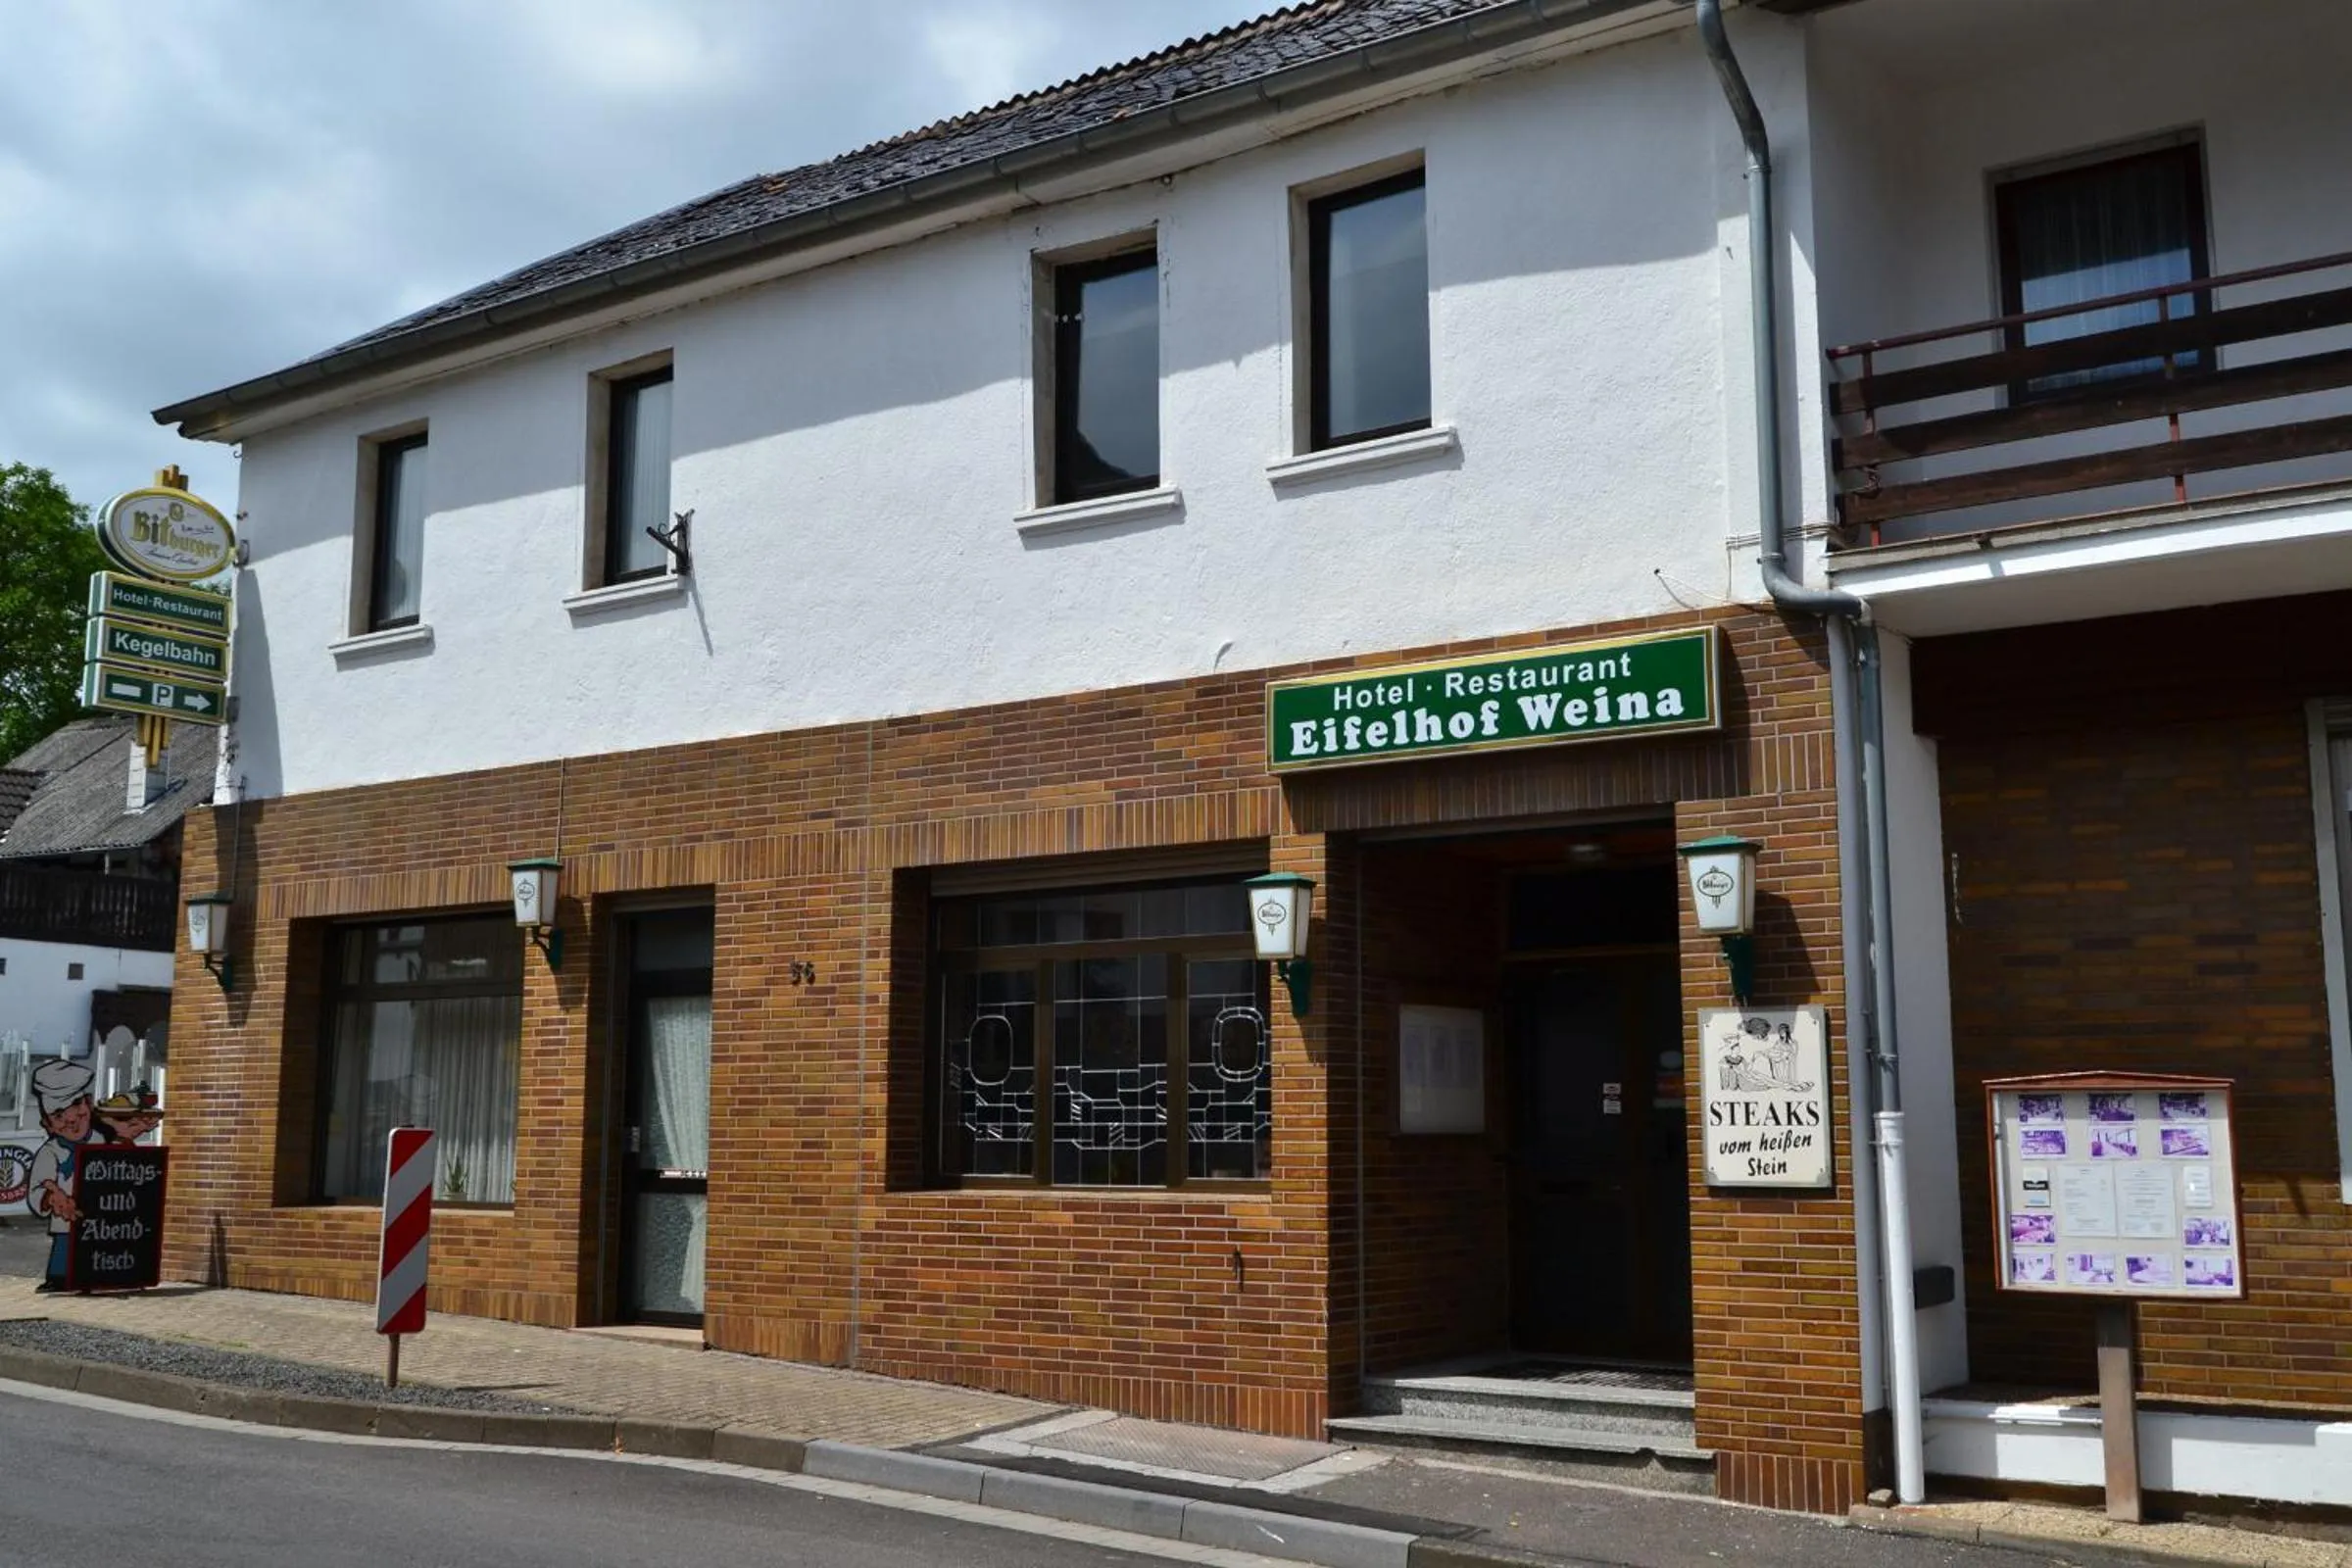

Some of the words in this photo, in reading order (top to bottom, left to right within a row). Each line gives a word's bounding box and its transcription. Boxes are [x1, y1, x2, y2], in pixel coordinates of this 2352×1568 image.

[114, 588, 222, 621] Hotel-Restaurant
[115, 632, 216, 666] Kegelbahn
[1334, 678, 1414, 710] Hotel
[1445, 652, 1632, 699] Restaurant
[156, 685, 171, 705] P
[1290, 700, 1501, 757] Eifelhof
[1516, 686, 1686, 731] Weina
[1709, 1101, 1820, 1127] STEAKS
[1719, 1140, 1751, 1155] vom
[1759, 1129, 1812, 1153] heißen
[84, 1159, 163, 1187] Mittags-
[1747, 1157, 1788, 1177] Stein
[99, 1191, 137, 1211] und
[80, 1217, 152, 1242] Abend-
